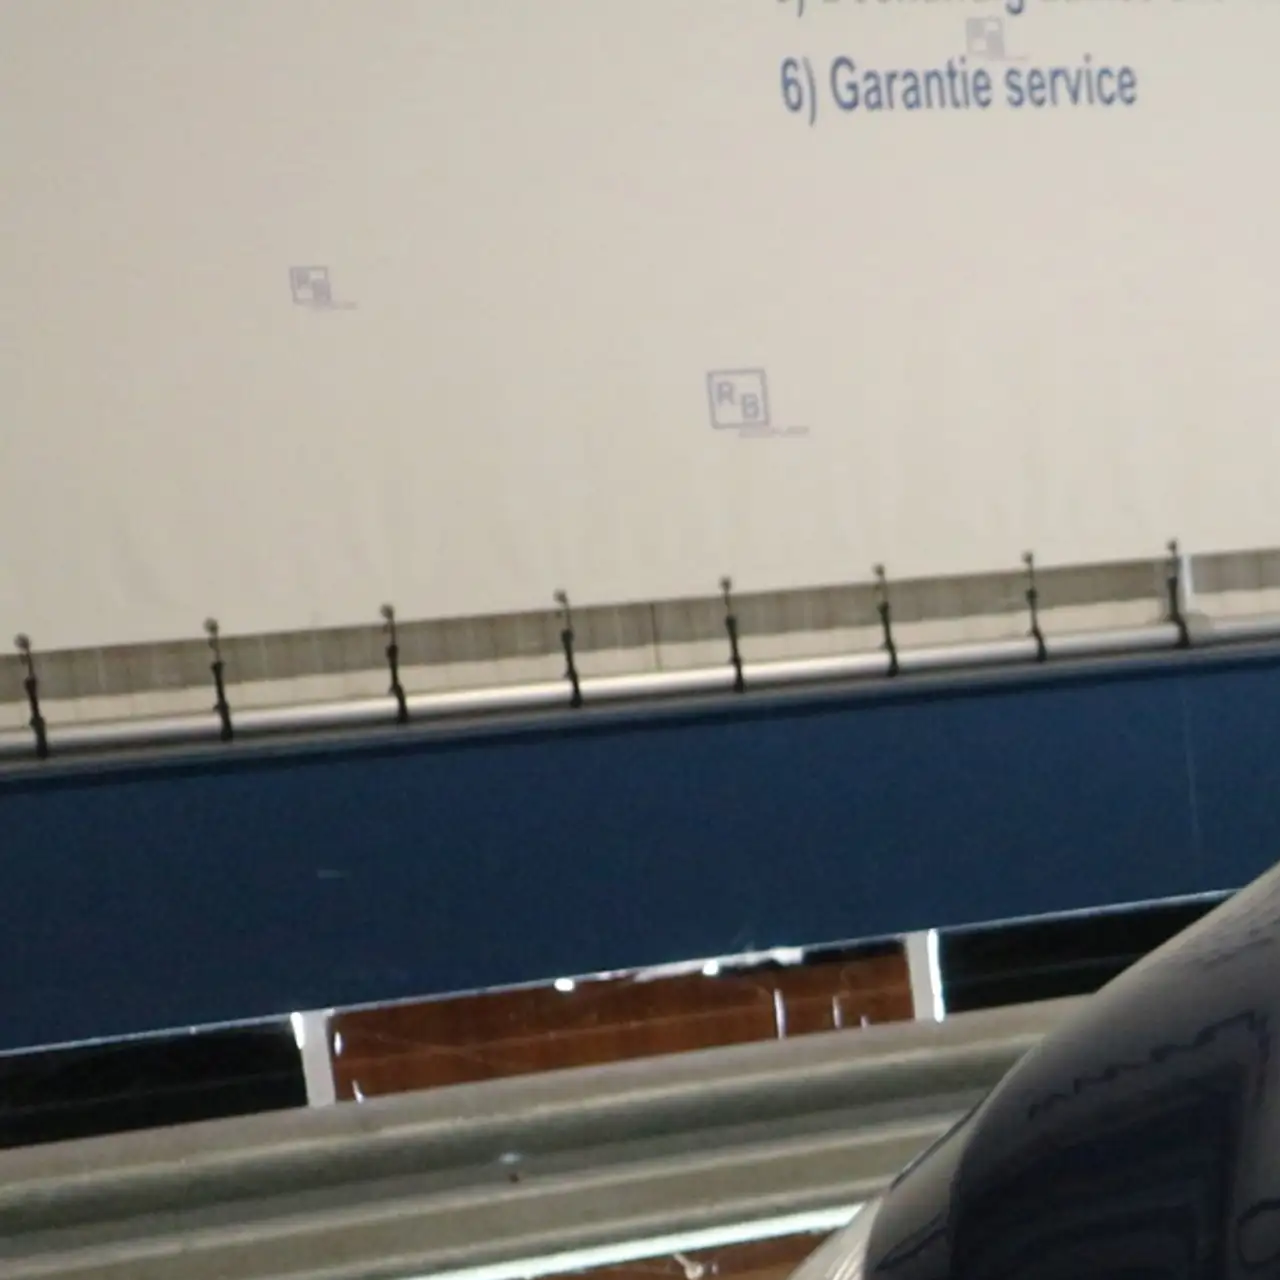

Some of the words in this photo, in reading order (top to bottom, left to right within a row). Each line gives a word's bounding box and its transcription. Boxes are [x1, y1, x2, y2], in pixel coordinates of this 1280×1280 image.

[780, 57, 817, 127] 6)
[829, 55, 993, 112] Garantie
[1005, 53, 1137, 108] service
